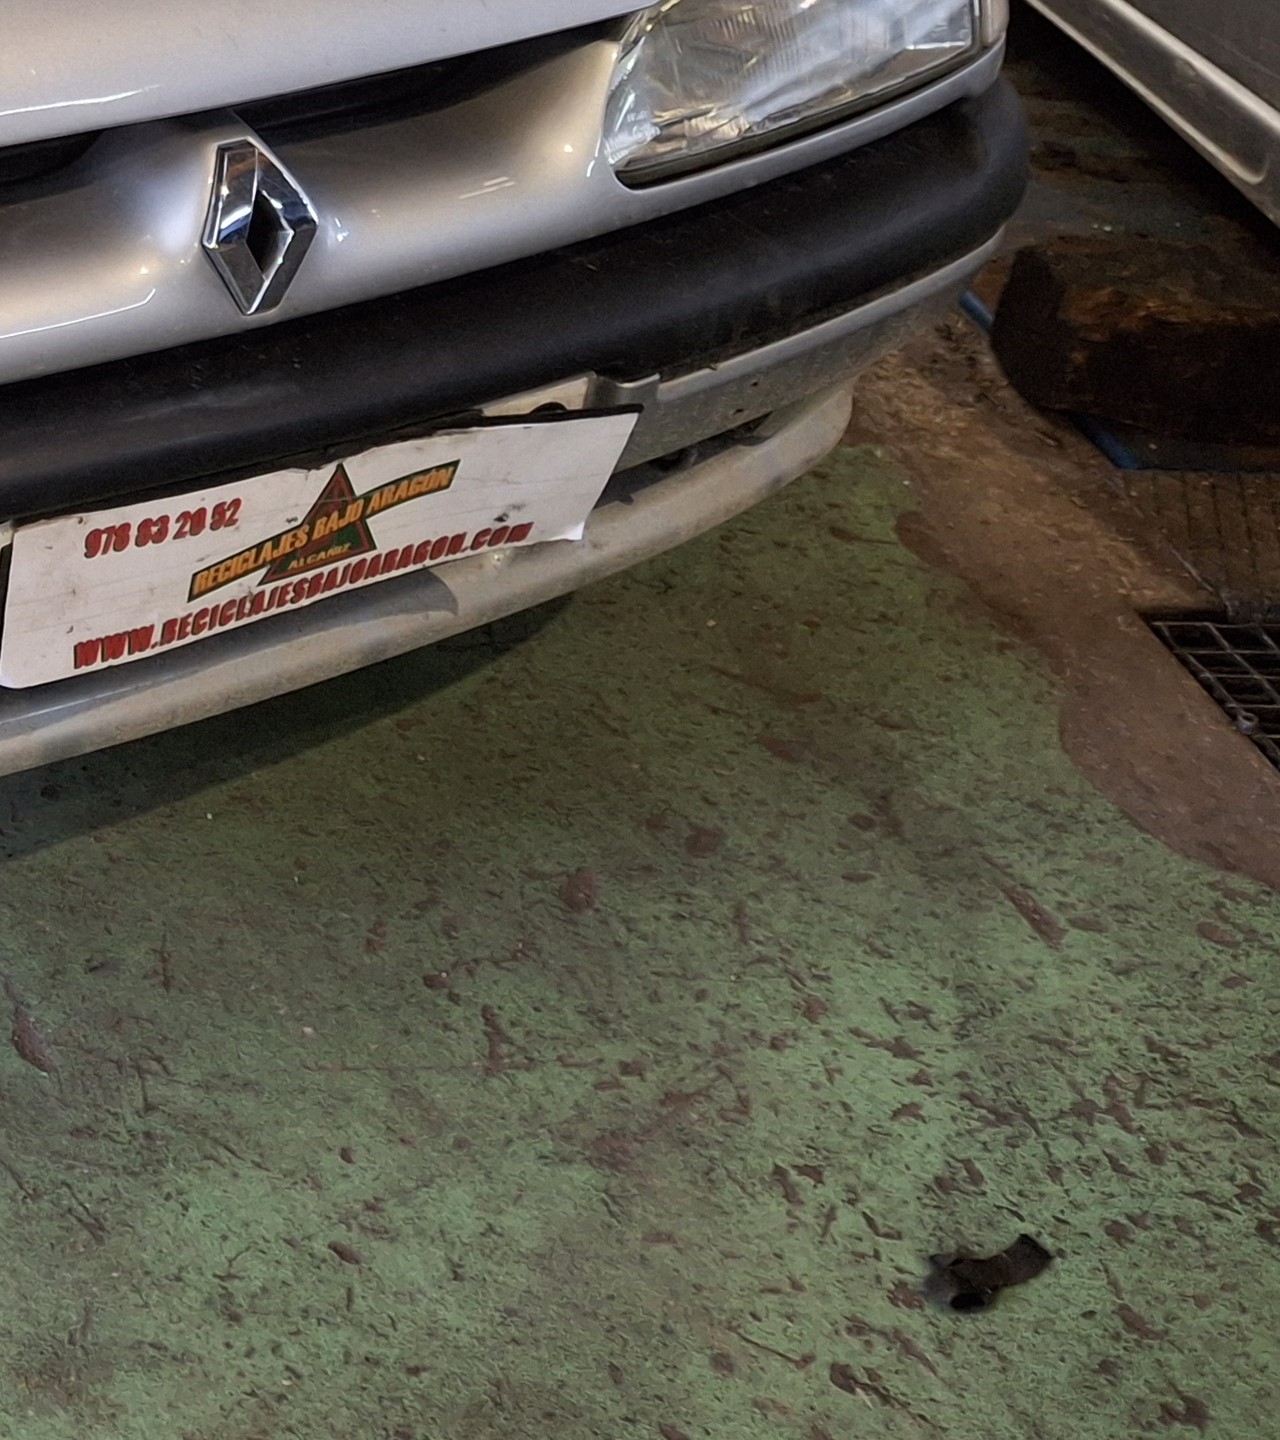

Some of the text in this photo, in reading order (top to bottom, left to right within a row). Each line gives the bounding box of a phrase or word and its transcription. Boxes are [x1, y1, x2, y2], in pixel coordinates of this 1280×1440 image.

[84, 497, 243, 559] 978 83 20 52
[195, 524, 311, 595] RECICLAJES
[312, 498, 365, 540] BAJO
